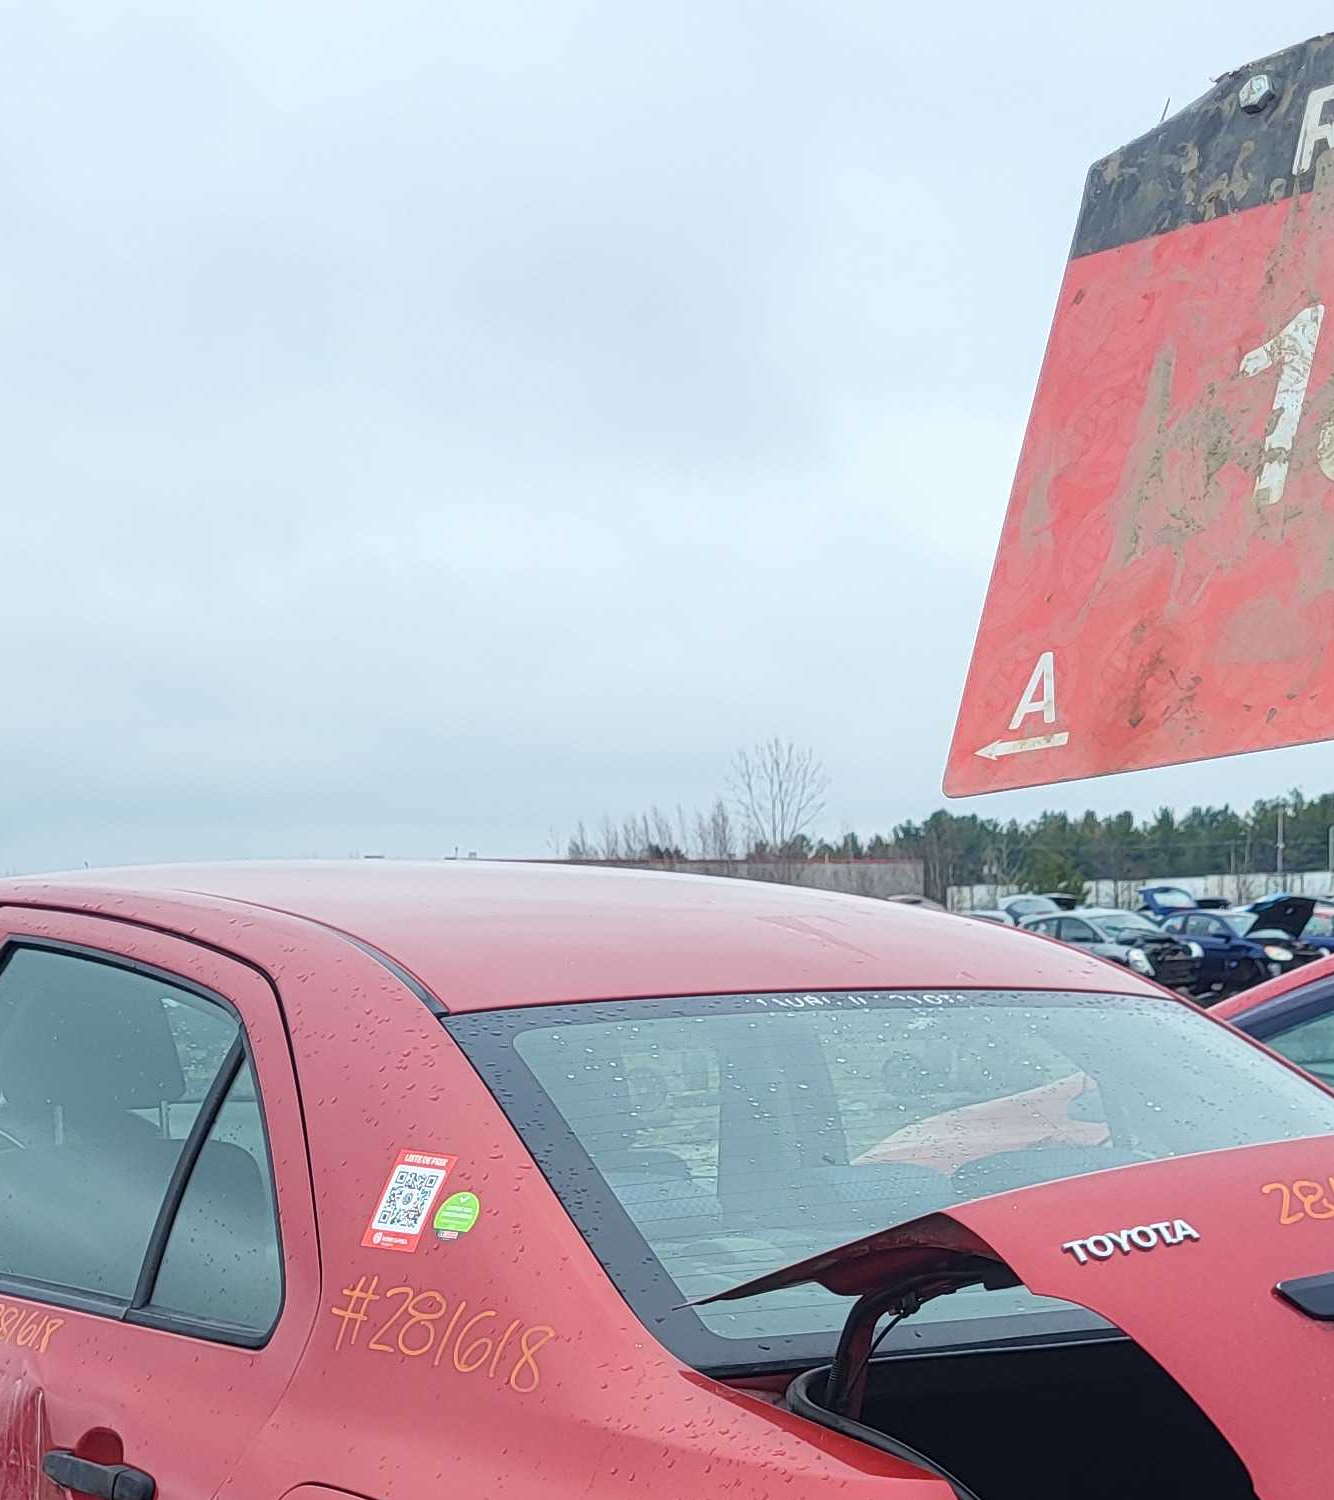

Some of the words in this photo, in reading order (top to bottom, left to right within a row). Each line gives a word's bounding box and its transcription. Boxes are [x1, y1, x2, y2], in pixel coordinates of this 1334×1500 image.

[1009, 651, 1055, 730] A
[1061, 1218, 1201, 1266] TOYOTA
[331, 1275, 555, 1393] #281618
